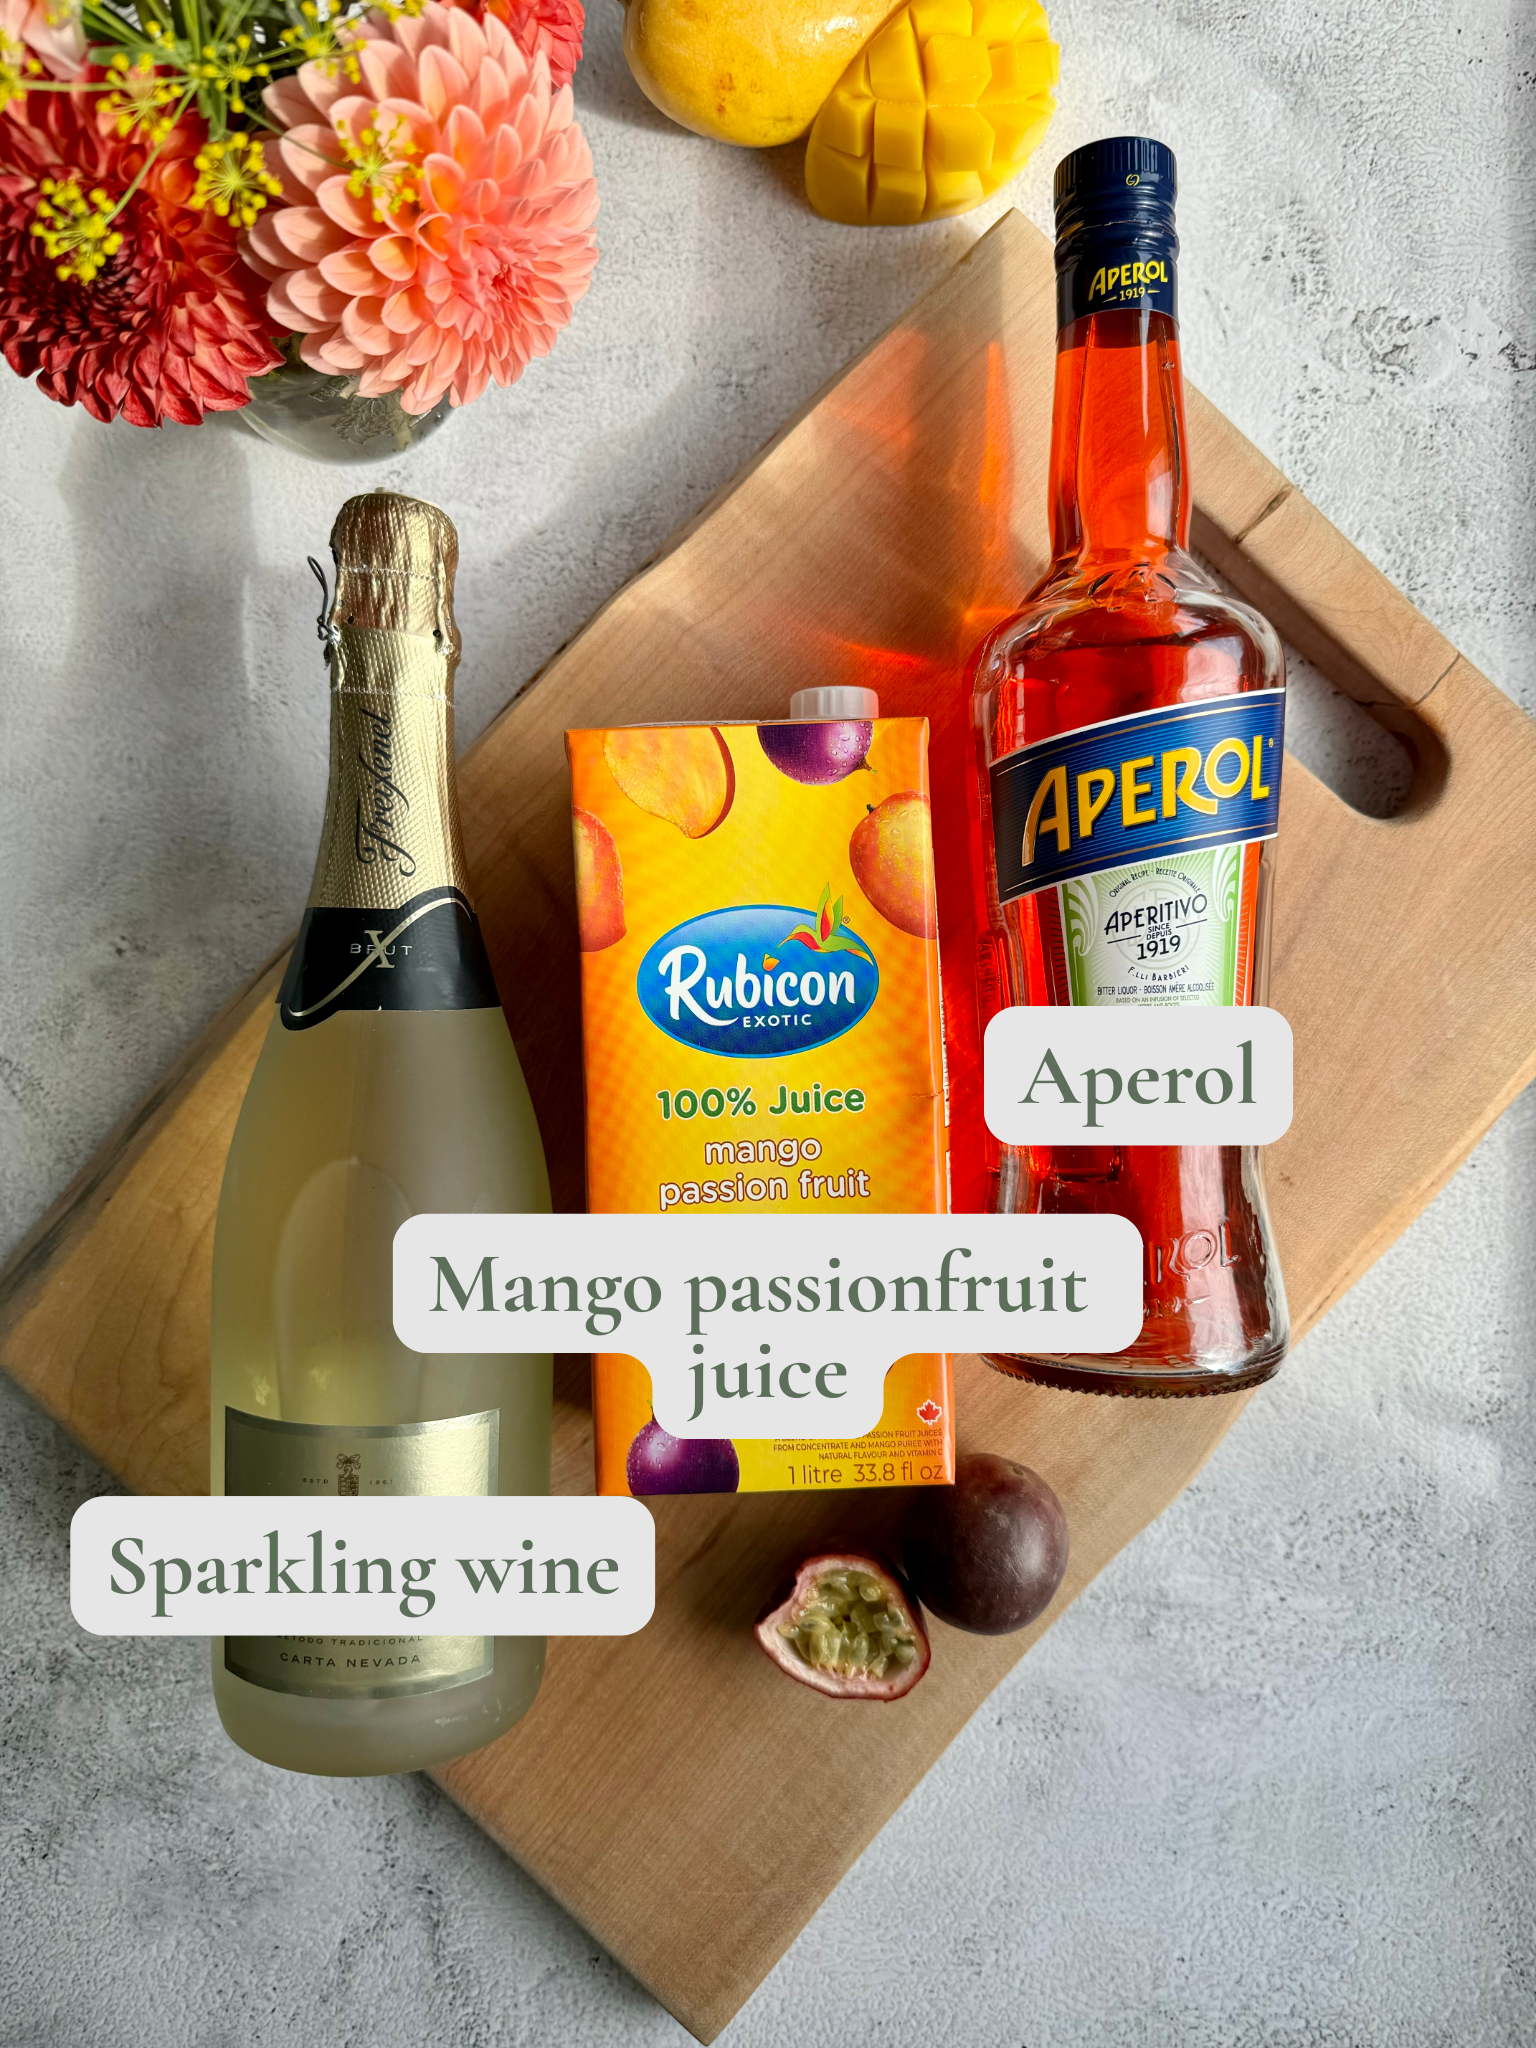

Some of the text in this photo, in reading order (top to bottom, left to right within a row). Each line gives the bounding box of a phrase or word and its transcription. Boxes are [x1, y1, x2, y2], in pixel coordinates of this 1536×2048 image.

[1088, 260, 1168, 301] APEROL
[1120, 287, 1146, 301] 1919
[1022, 734, 1270, 867] APEROL
[1104, 894, 1208, 935] APERITIVO
[1147, 929, 1172, 941] DEPUIS
[1148, 923, 1170, 933] SINCE
[1137, 935, 1181, 960] 1919
[1152, 965, 1190, 982] BARBIERI
[658, 944, 856, 1026] Rubicon
[1098, 986, 1116, 996] BITTER
[1118, 986, 1138, 995] LIQUOR
[1144, 985, 1167, 995] BOISSON
[743, 1013, 812, 1028] EXOTIC
[656, 1083, 866, 1121] 100% Juice
[704, 1137, 822, 1167] mango
[659, 1168, 871, 1212] passion fruit
[895, 1430, 916, 1438] FRUIT
[917, 1429, 942, 1437] JUICES
[774, 1439, 943, 1452] FROM CONCENTRATE AND MANGO PUREE WITH
[819, 1452, 851, 1460] NATURAL
[854, 1451, 887, 1460] FLAVOUR
[907, 1450, 937, 1458] VITAMIN
[788, 1462, 944, 1485] 1 litre 33.8 fl oz
[276, 1635, 424, 1647] ETODO TRADICIONAL
[280, 1652, 420, 1668] CARTA NEVADA
